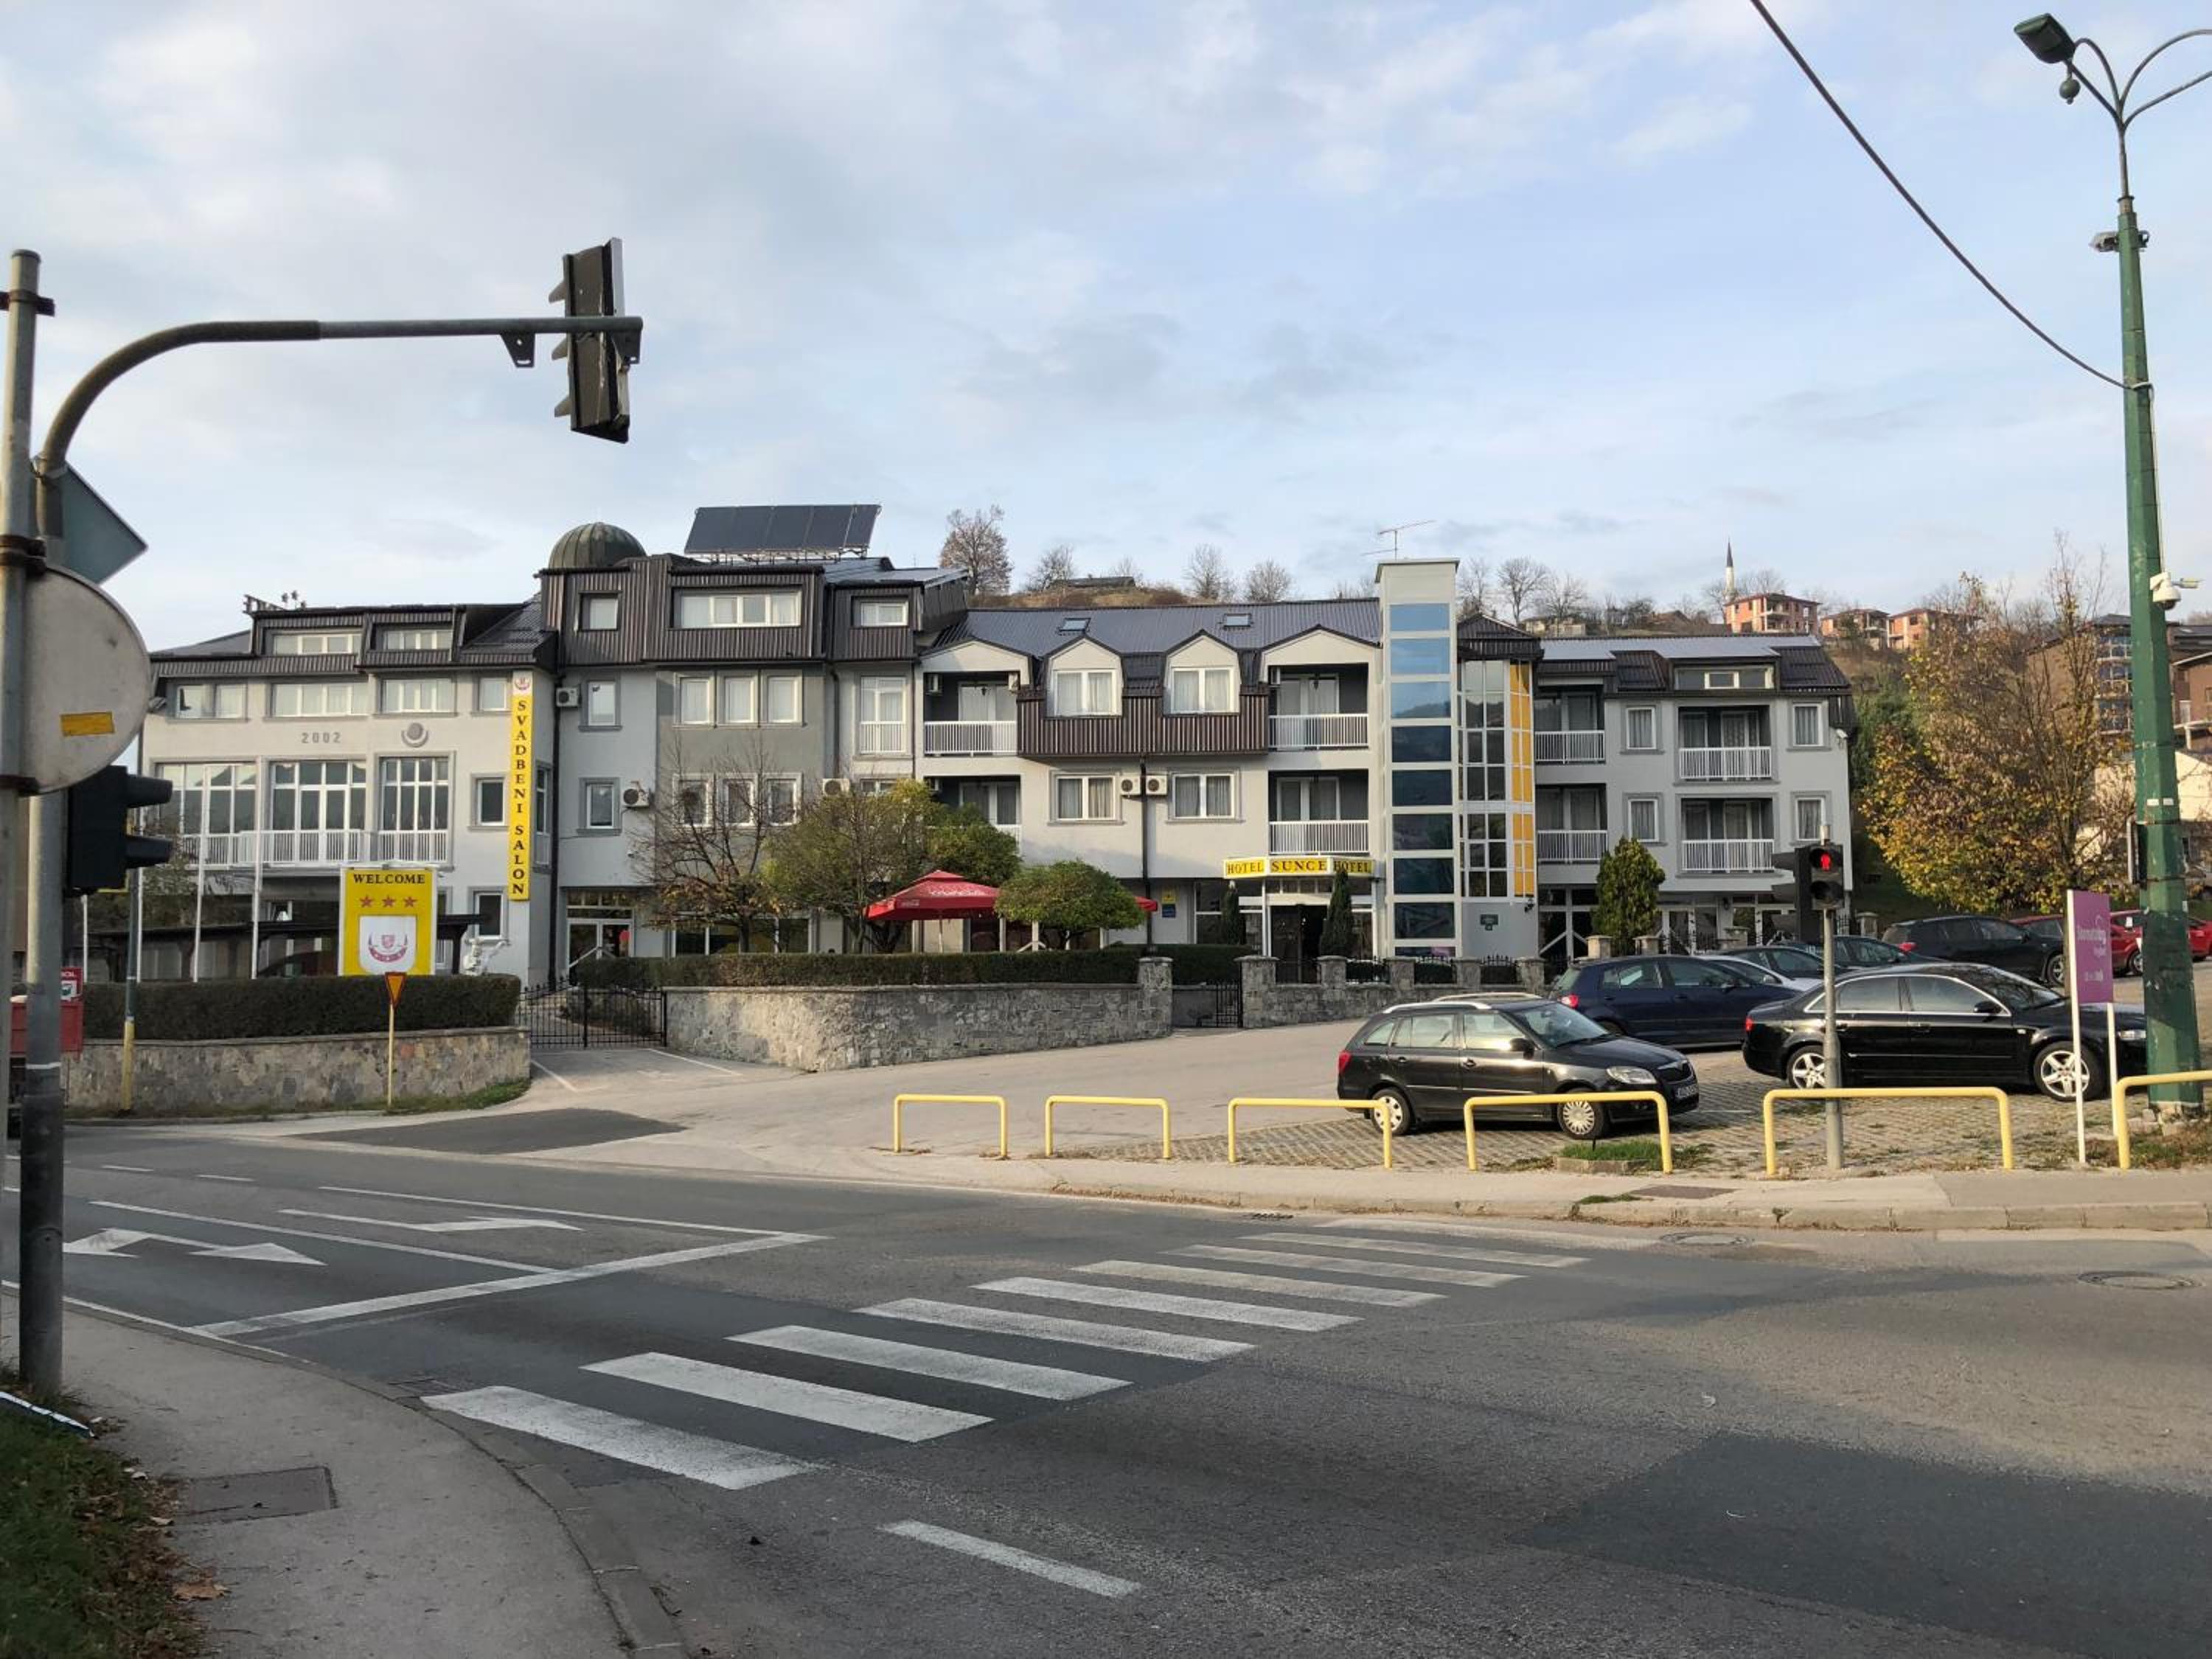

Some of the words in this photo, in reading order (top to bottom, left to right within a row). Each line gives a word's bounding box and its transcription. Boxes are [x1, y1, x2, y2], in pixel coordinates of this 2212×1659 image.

[302, 732, 341, 744] 2002
[514, 700, 529, 813] SVADBENI
[512, 825, 525, 894] SALON
[1272, 860, 1326, 872] SUNCE
[1228, 861, 1263, 874] HOTEL
[1333, 860, 1369, 873] HOTEL
[354, 874, 425, 884] WELCOME
